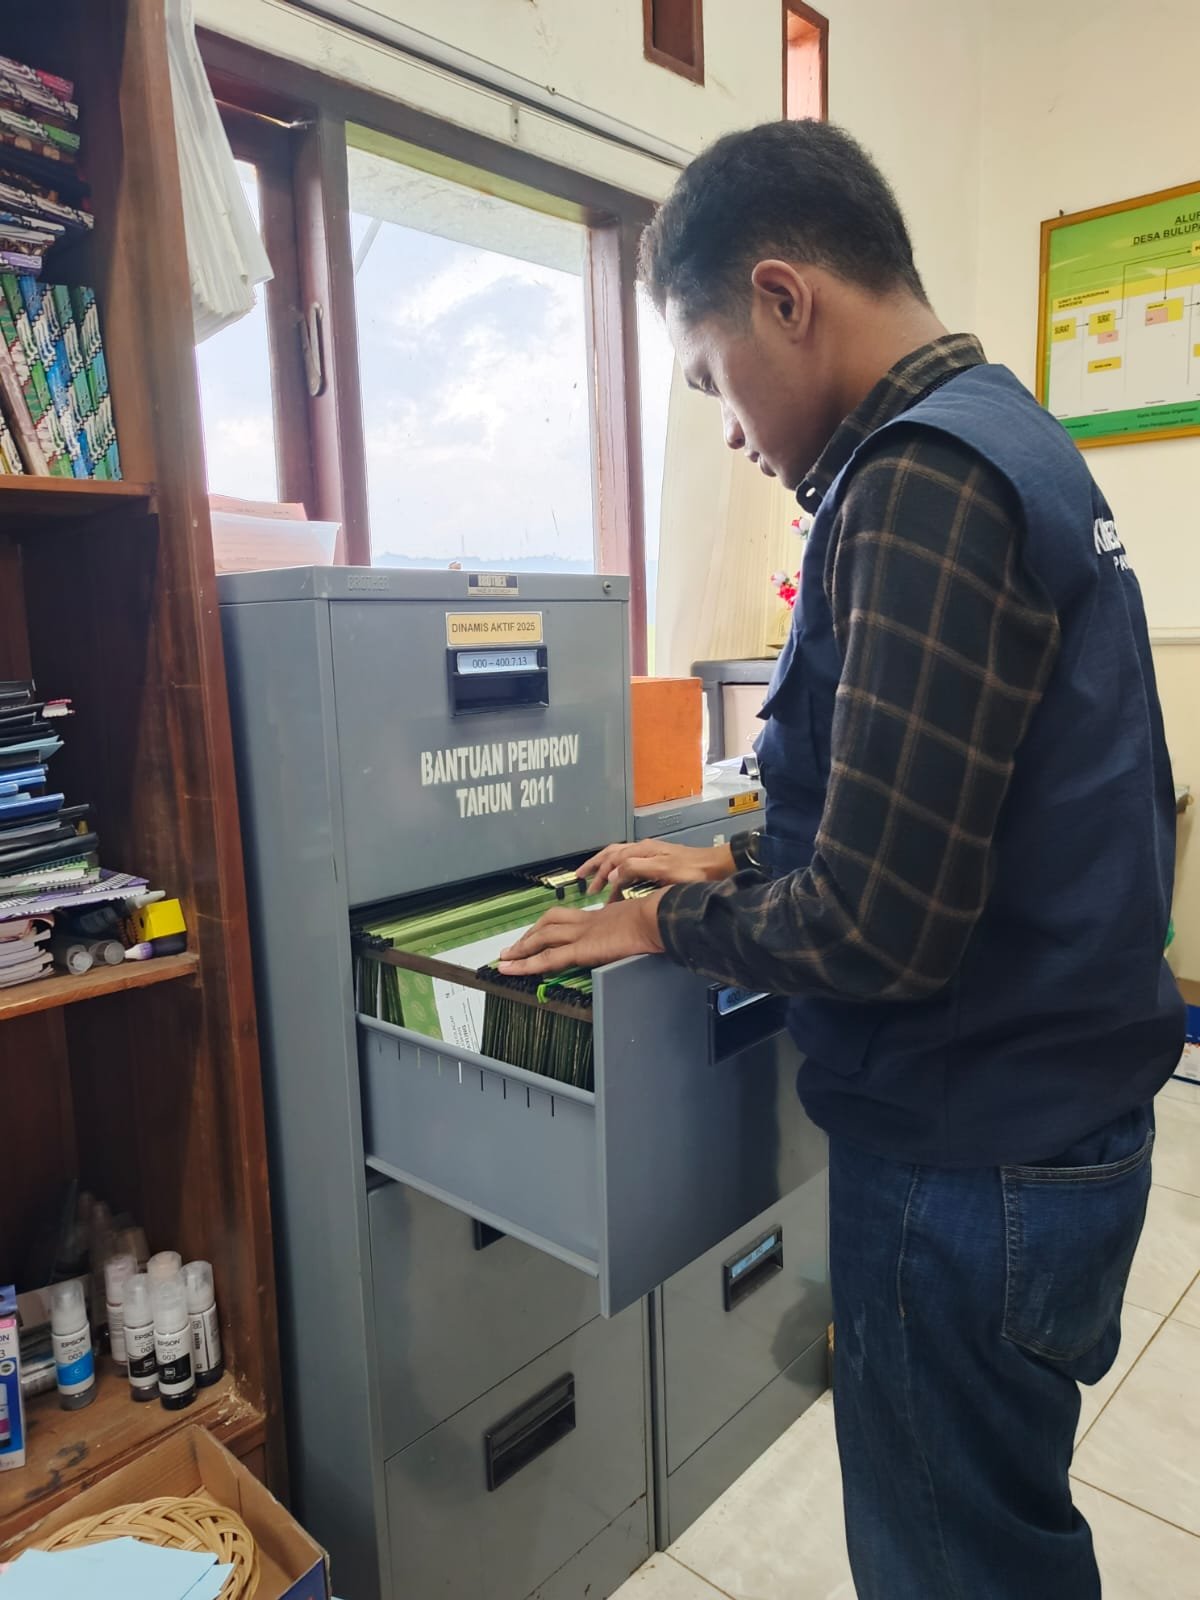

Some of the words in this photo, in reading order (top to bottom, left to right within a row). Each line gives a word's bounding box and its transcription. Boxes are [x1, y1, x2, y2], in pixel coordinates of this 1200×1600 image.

[1132, 232, 1160, 245] DESA
[451, 622, 489, 633] DINAMIS
[490, 622, 515, 632] AKTIF
[516, 621, 536, 631] 2025
[472, 659, 488, 668] 000
[495, 656, 528, 667] 400.7.13
[420, 743, 504, 786] BANTUAN
[507, 734, 579, 773] PEMPROV
[456, 782, 512, 818] TAHUN
[520, 775, 554, 808] 2011
[61, 1336, 85, 1348] EPSON
[157, 1337, 181, 1347] EPSON
